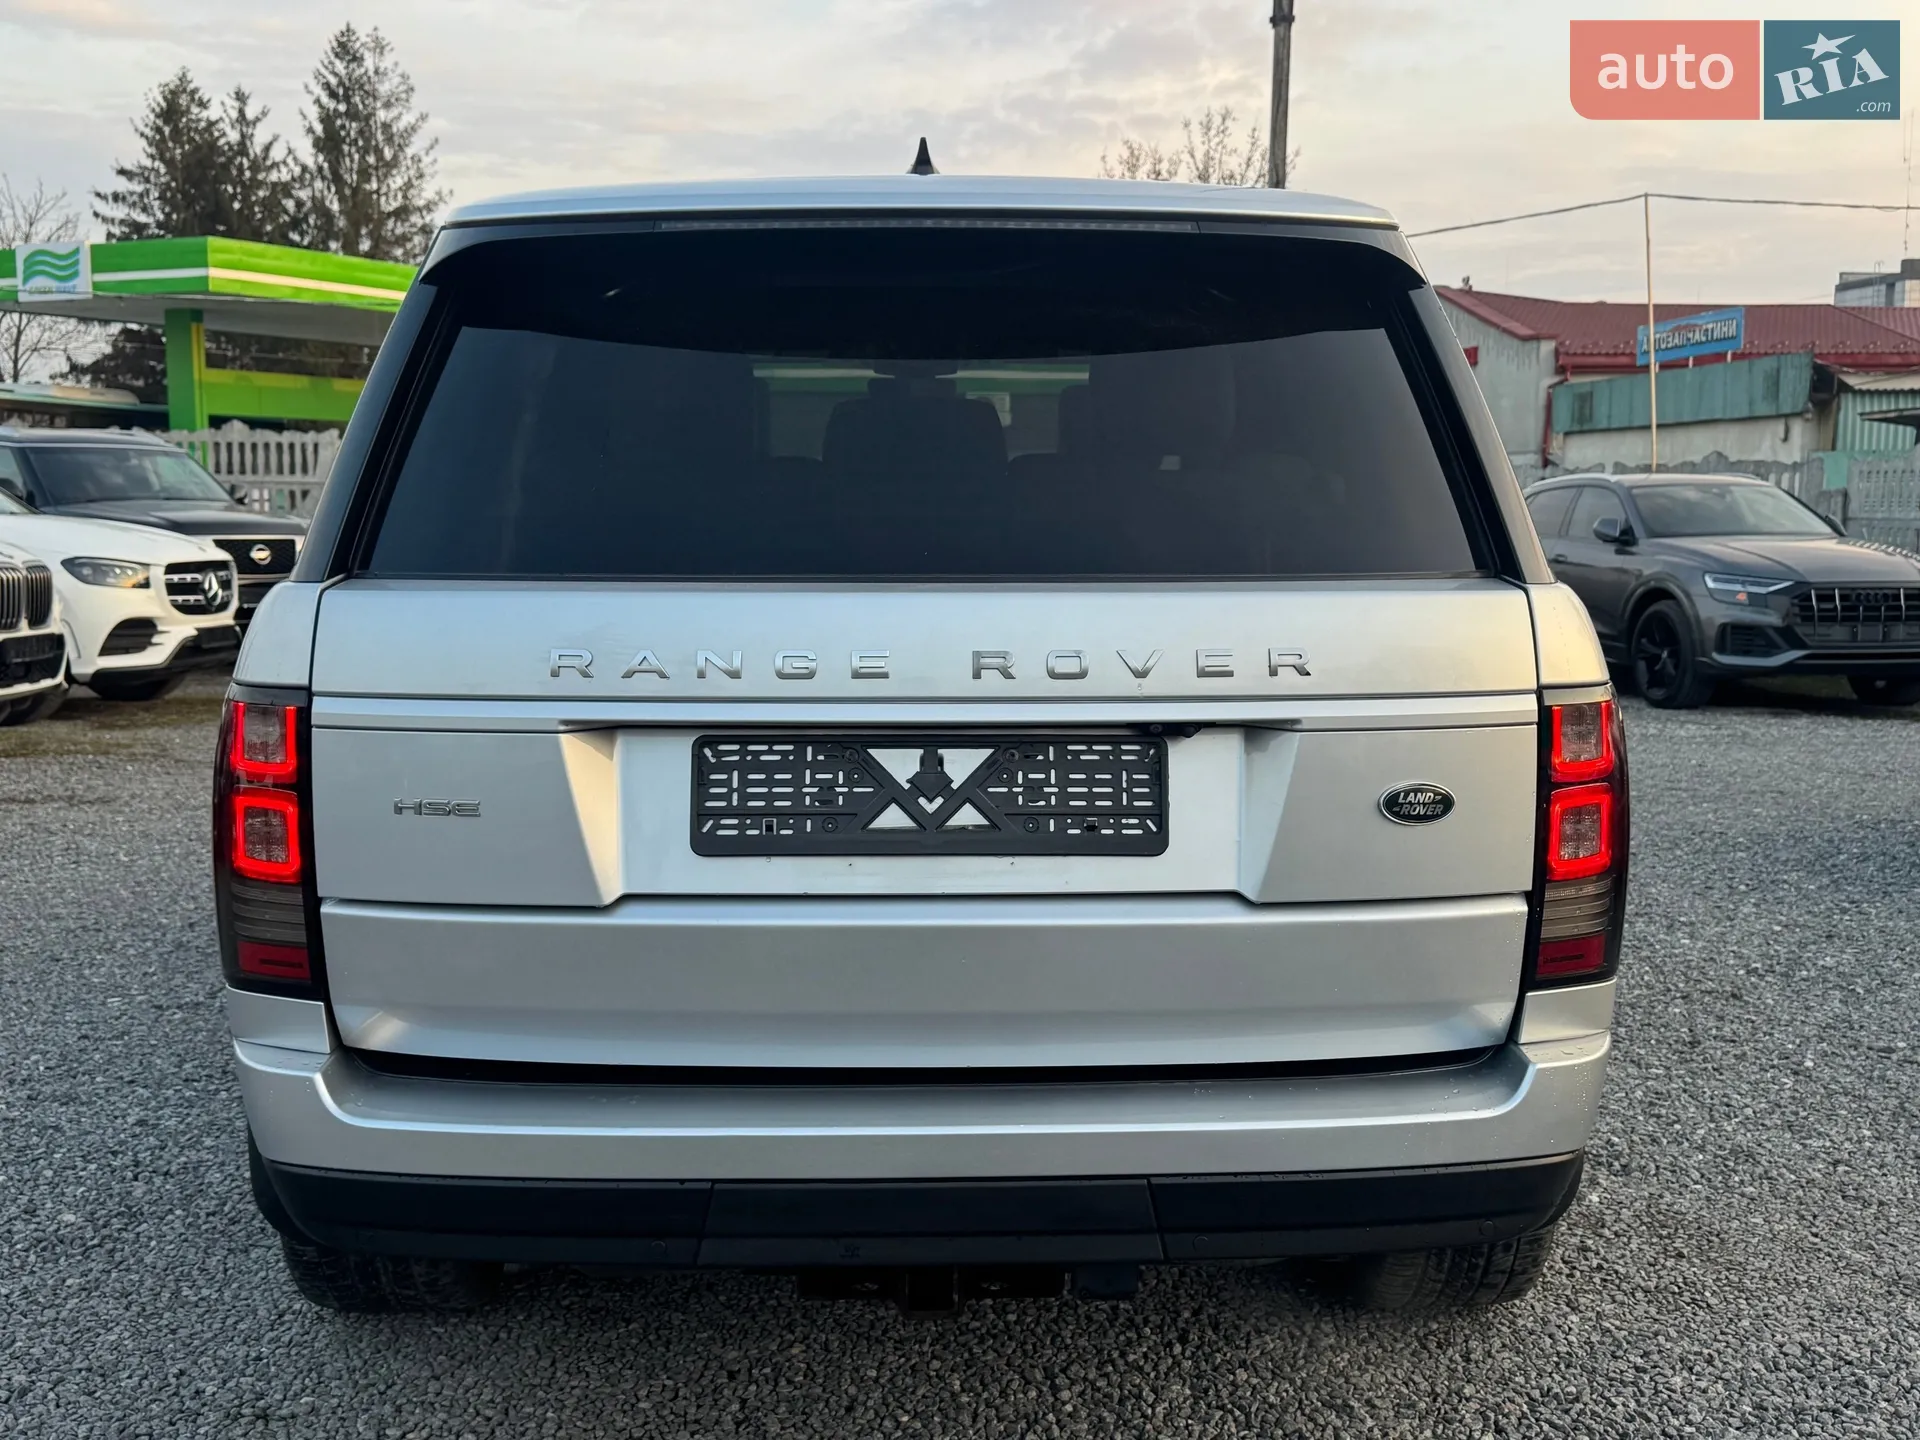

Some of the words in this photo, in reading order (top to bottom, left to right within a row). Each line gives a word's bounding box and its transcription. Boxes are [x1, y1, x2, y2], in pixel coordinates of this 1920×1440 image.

[1641, 318, 1738, 353] АТОЗАПЧАСТИНИ
[550, 648, 890, 680] RANGE
[972, 646, 1312, 680] ROVER
[393, 797, 481, 817] HSE
[1398, 792, 1435, 804] LAND
[1400, 804, 1444, 815] ROVER
